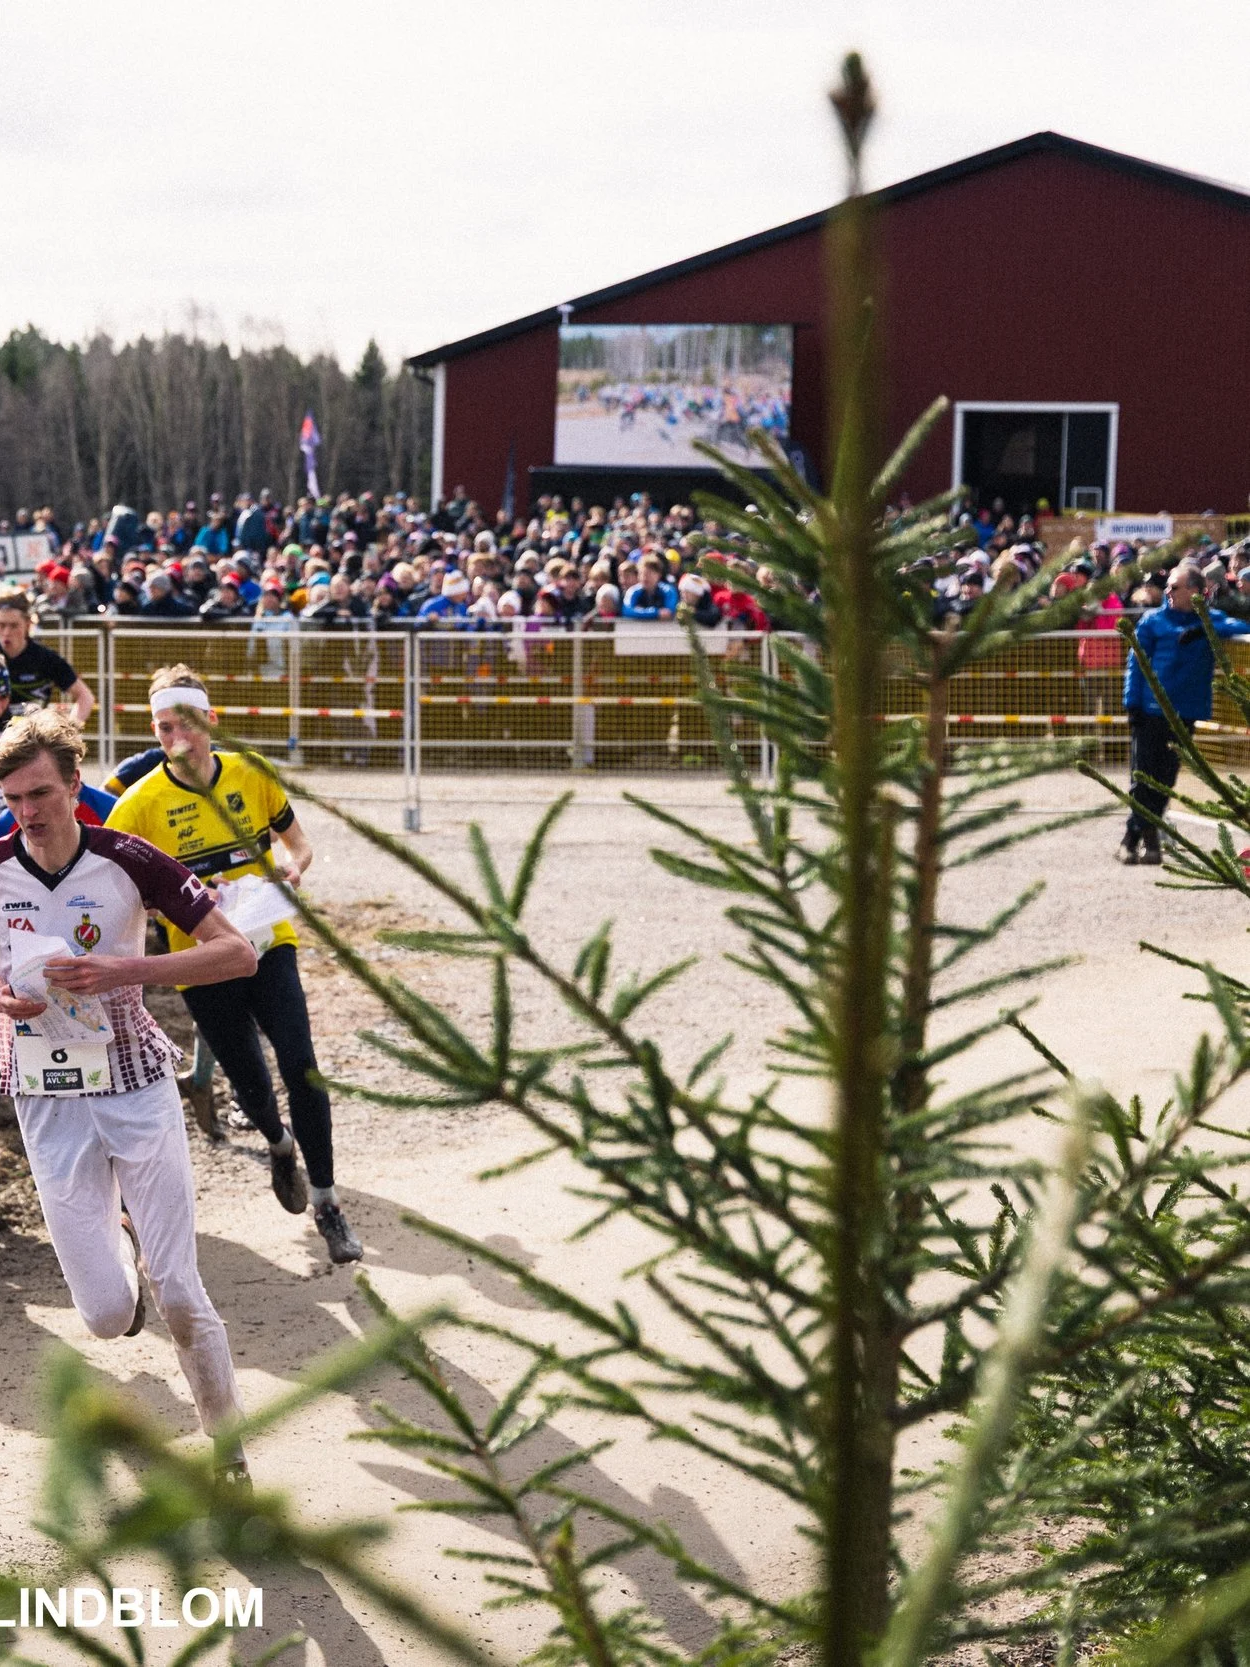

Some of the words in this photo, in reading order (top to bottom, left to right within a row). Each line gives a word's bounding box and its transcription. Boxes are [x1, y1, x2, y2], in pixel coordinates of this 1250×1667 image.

[5, 901, 33, 909] EWES
[7, 917, 36, 932] ICA
[51, 1048, 68, 1064] 6
